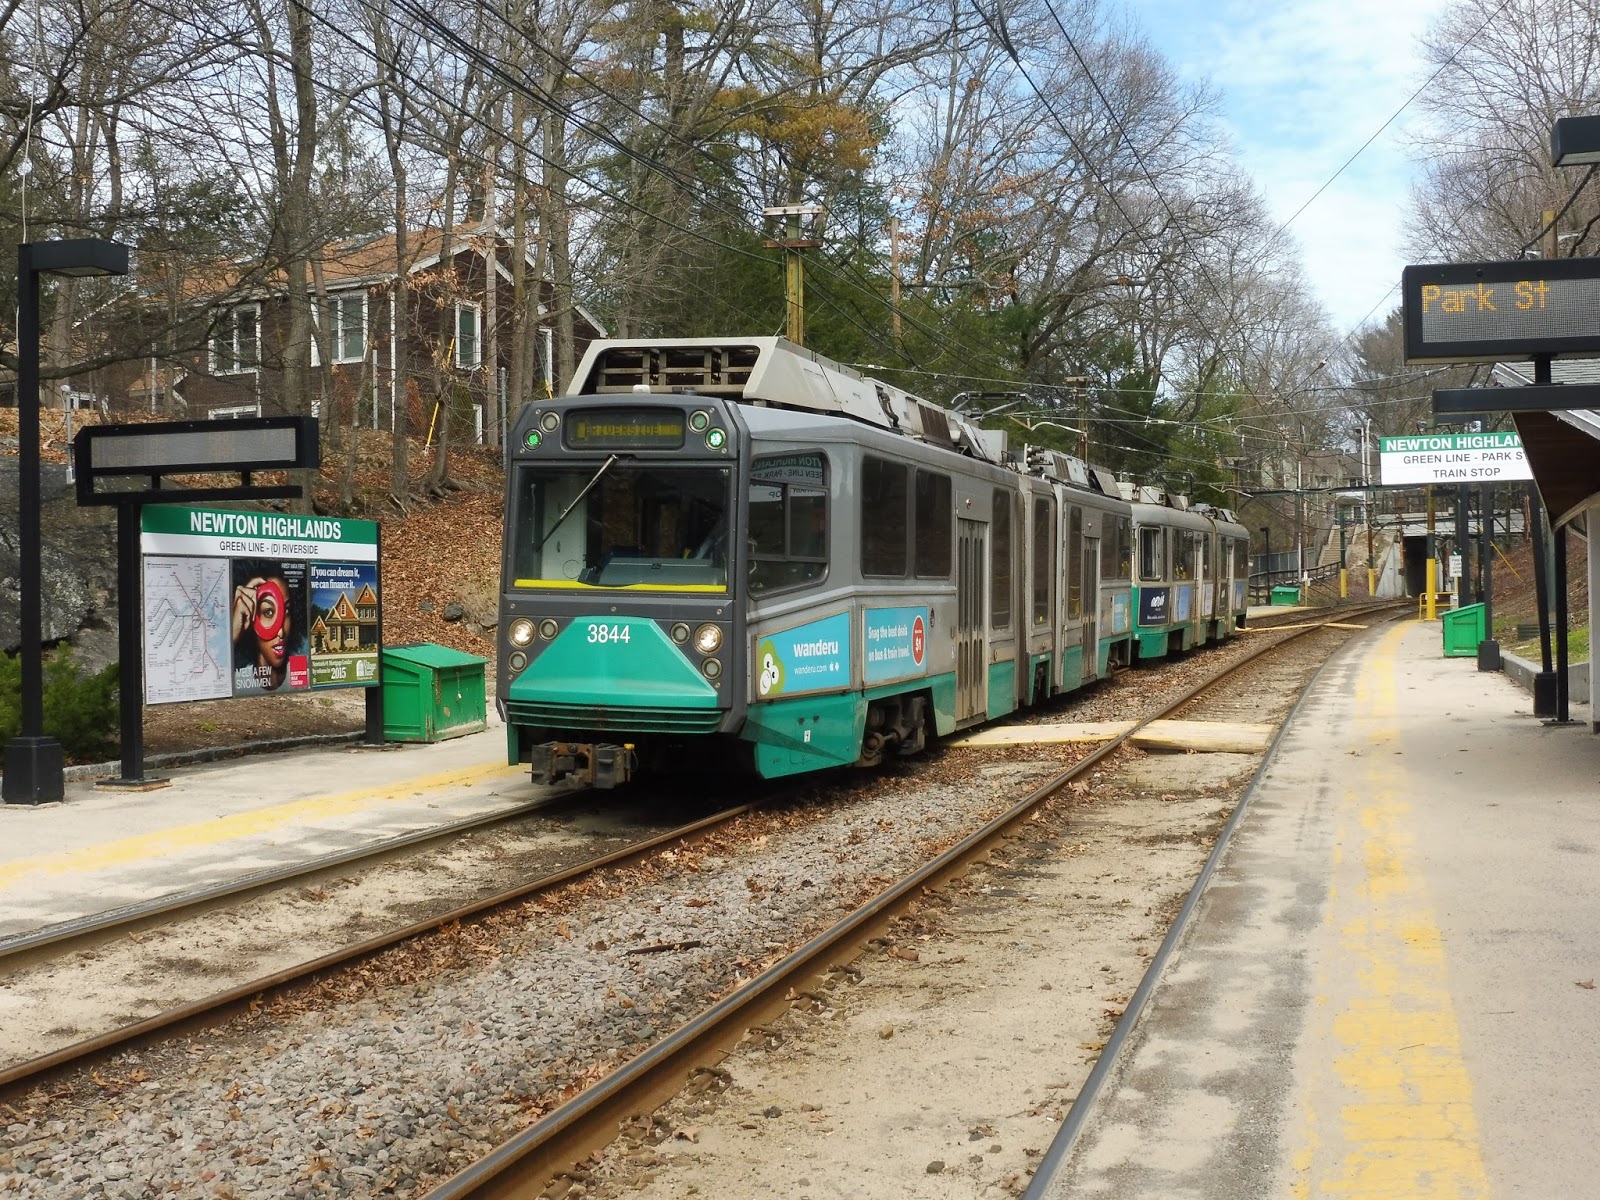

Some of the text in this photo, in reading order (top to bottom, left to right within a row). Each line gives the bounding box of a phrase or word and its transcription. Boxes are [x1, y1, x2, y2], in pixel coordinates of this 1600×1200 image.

[1421, 280, 1550, 314] Park St
[591, 424, 660, 436] RIVERSIDE
[1386, 437, 1452, 452] NEWTON
[1403, 454, 1441, 464] GREEN
[1446, 453, 1471, 463] LINE
[1482, 452, 1512, 462] PARK
[1433, 467, 1500, 478] TRAIN STOP
[190, 511, 342, 540] NEWTON HIGHLANDS
[219, 540, 247, 552] GREEN
[248, 542, 265, 552] LINE
[270, 543, 281, 555] (D)
[282, 544, 318, 555] RIVERSIDE
[310, 566, 316, 577] If
[316, 569, 327, 579] you
[336, 567, 354, 578] dream
[310, 580, 319, 589] we
[319, 581, 329, 589] can
[329, 579, 350, 589] finance
[587, 623, 631, 644] 3844
[793, 639, 839, 658] wanderu
[258, 666, 272, 676] FEW
[330, 666, 347, 680] 2015
[794, 662, 827, 675] wanderu.com
[236, 677, 271, 690] SNOWMEN
